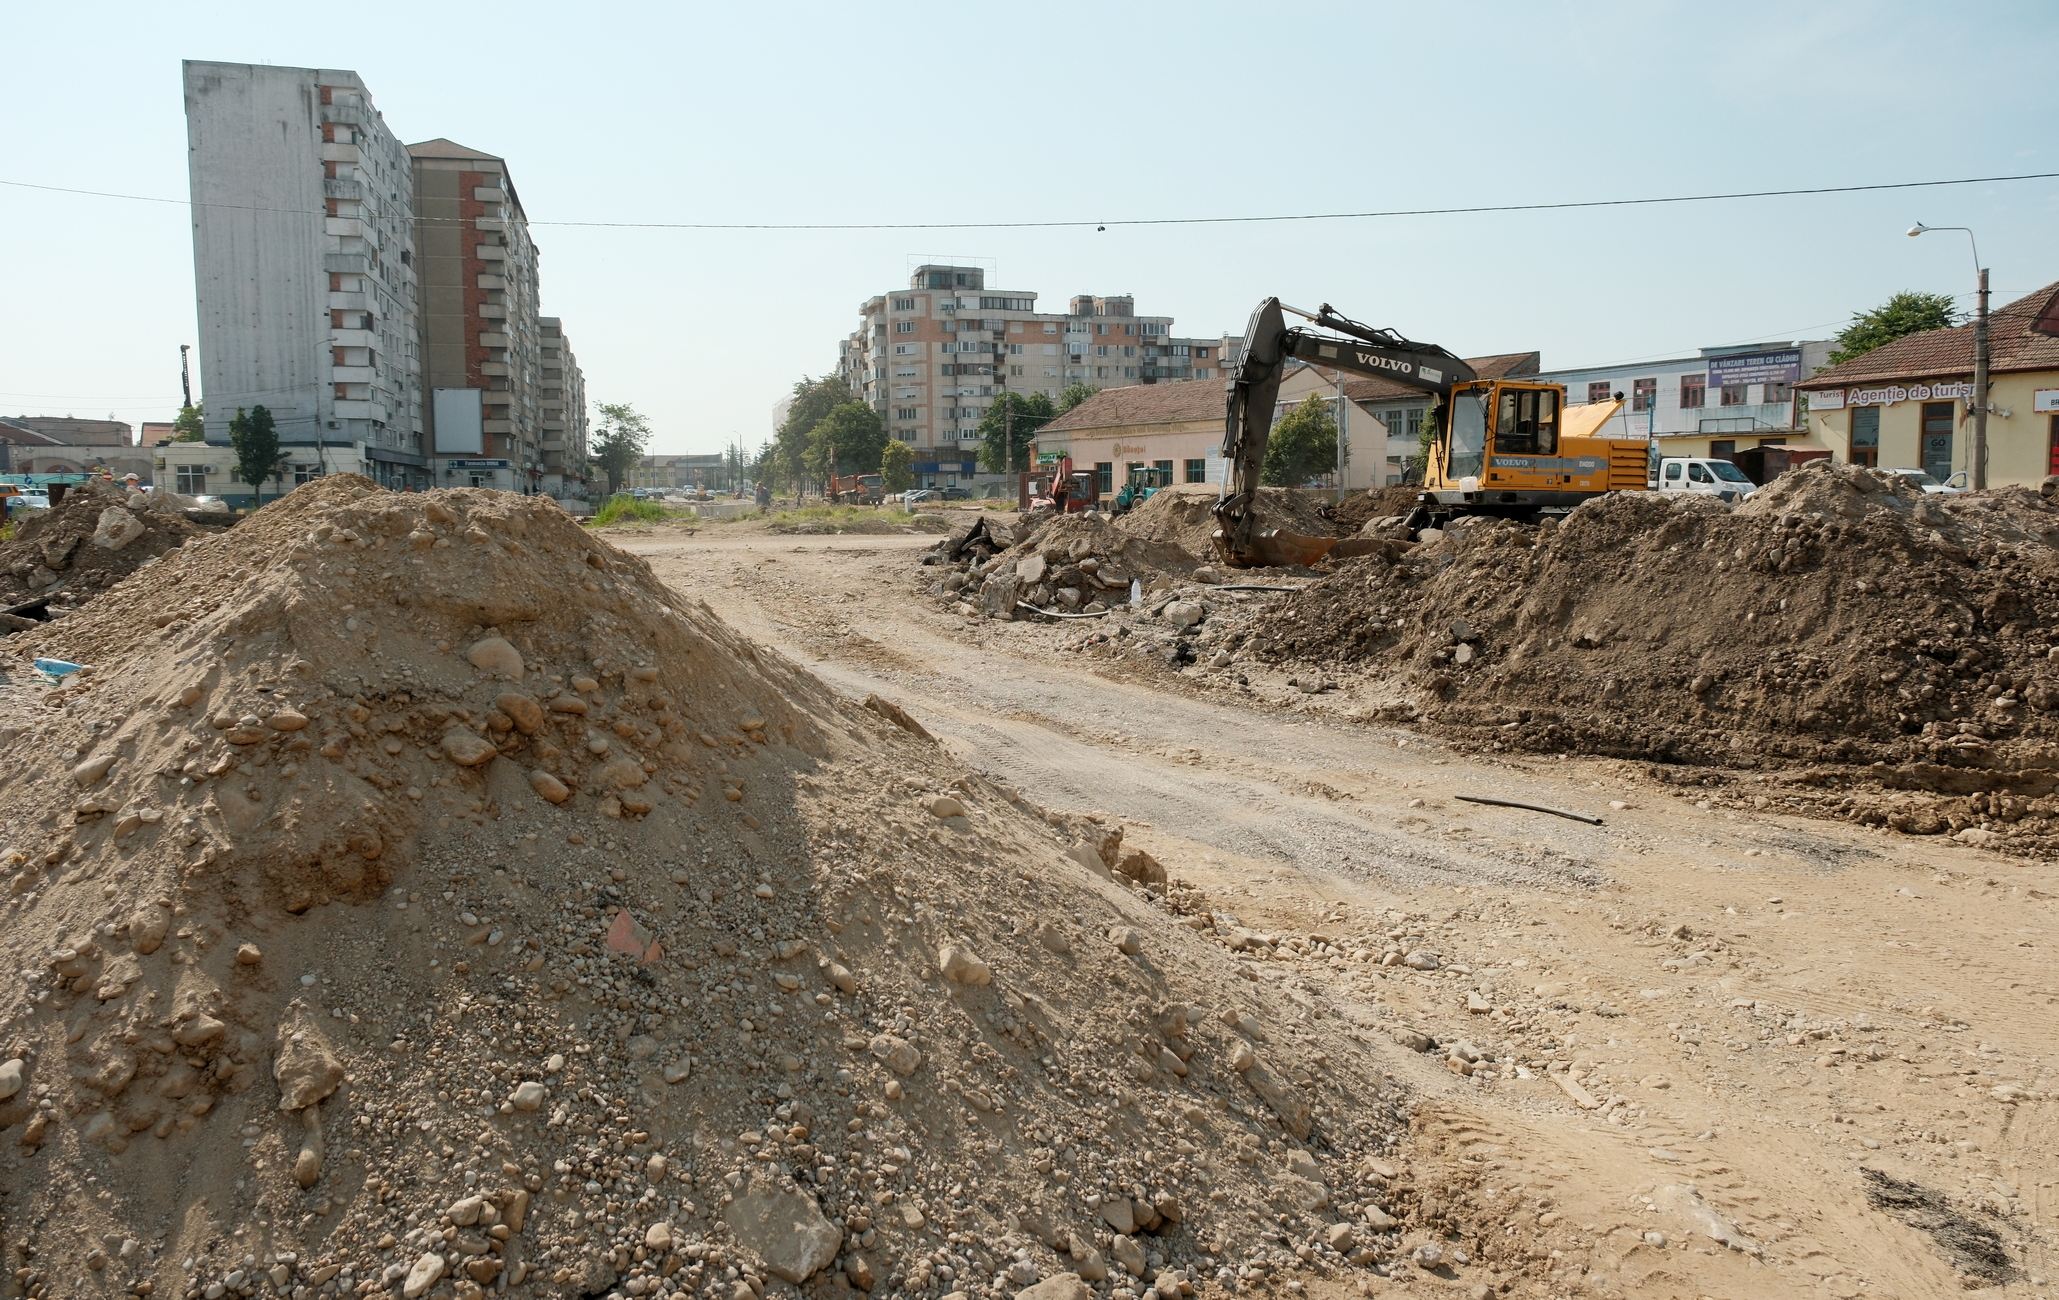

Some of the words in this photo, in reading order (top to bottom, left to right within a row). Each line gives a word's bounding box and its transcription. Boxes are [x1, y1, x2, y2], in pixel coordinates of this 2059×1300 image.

[1356, 352, 1412, 373] VOLVO
[1746, 357, 1765, 365] TEREN
[1765, 356, 1774, 364] CU
[1819, 390, 1844, 398] Turist
[1850, 387, 1904, 403] Agenție
[1911, 386, 1928, 398] de
[1931, 439, 1946, 447] GO
[1494, 458, 1528, 466] VOLVO
